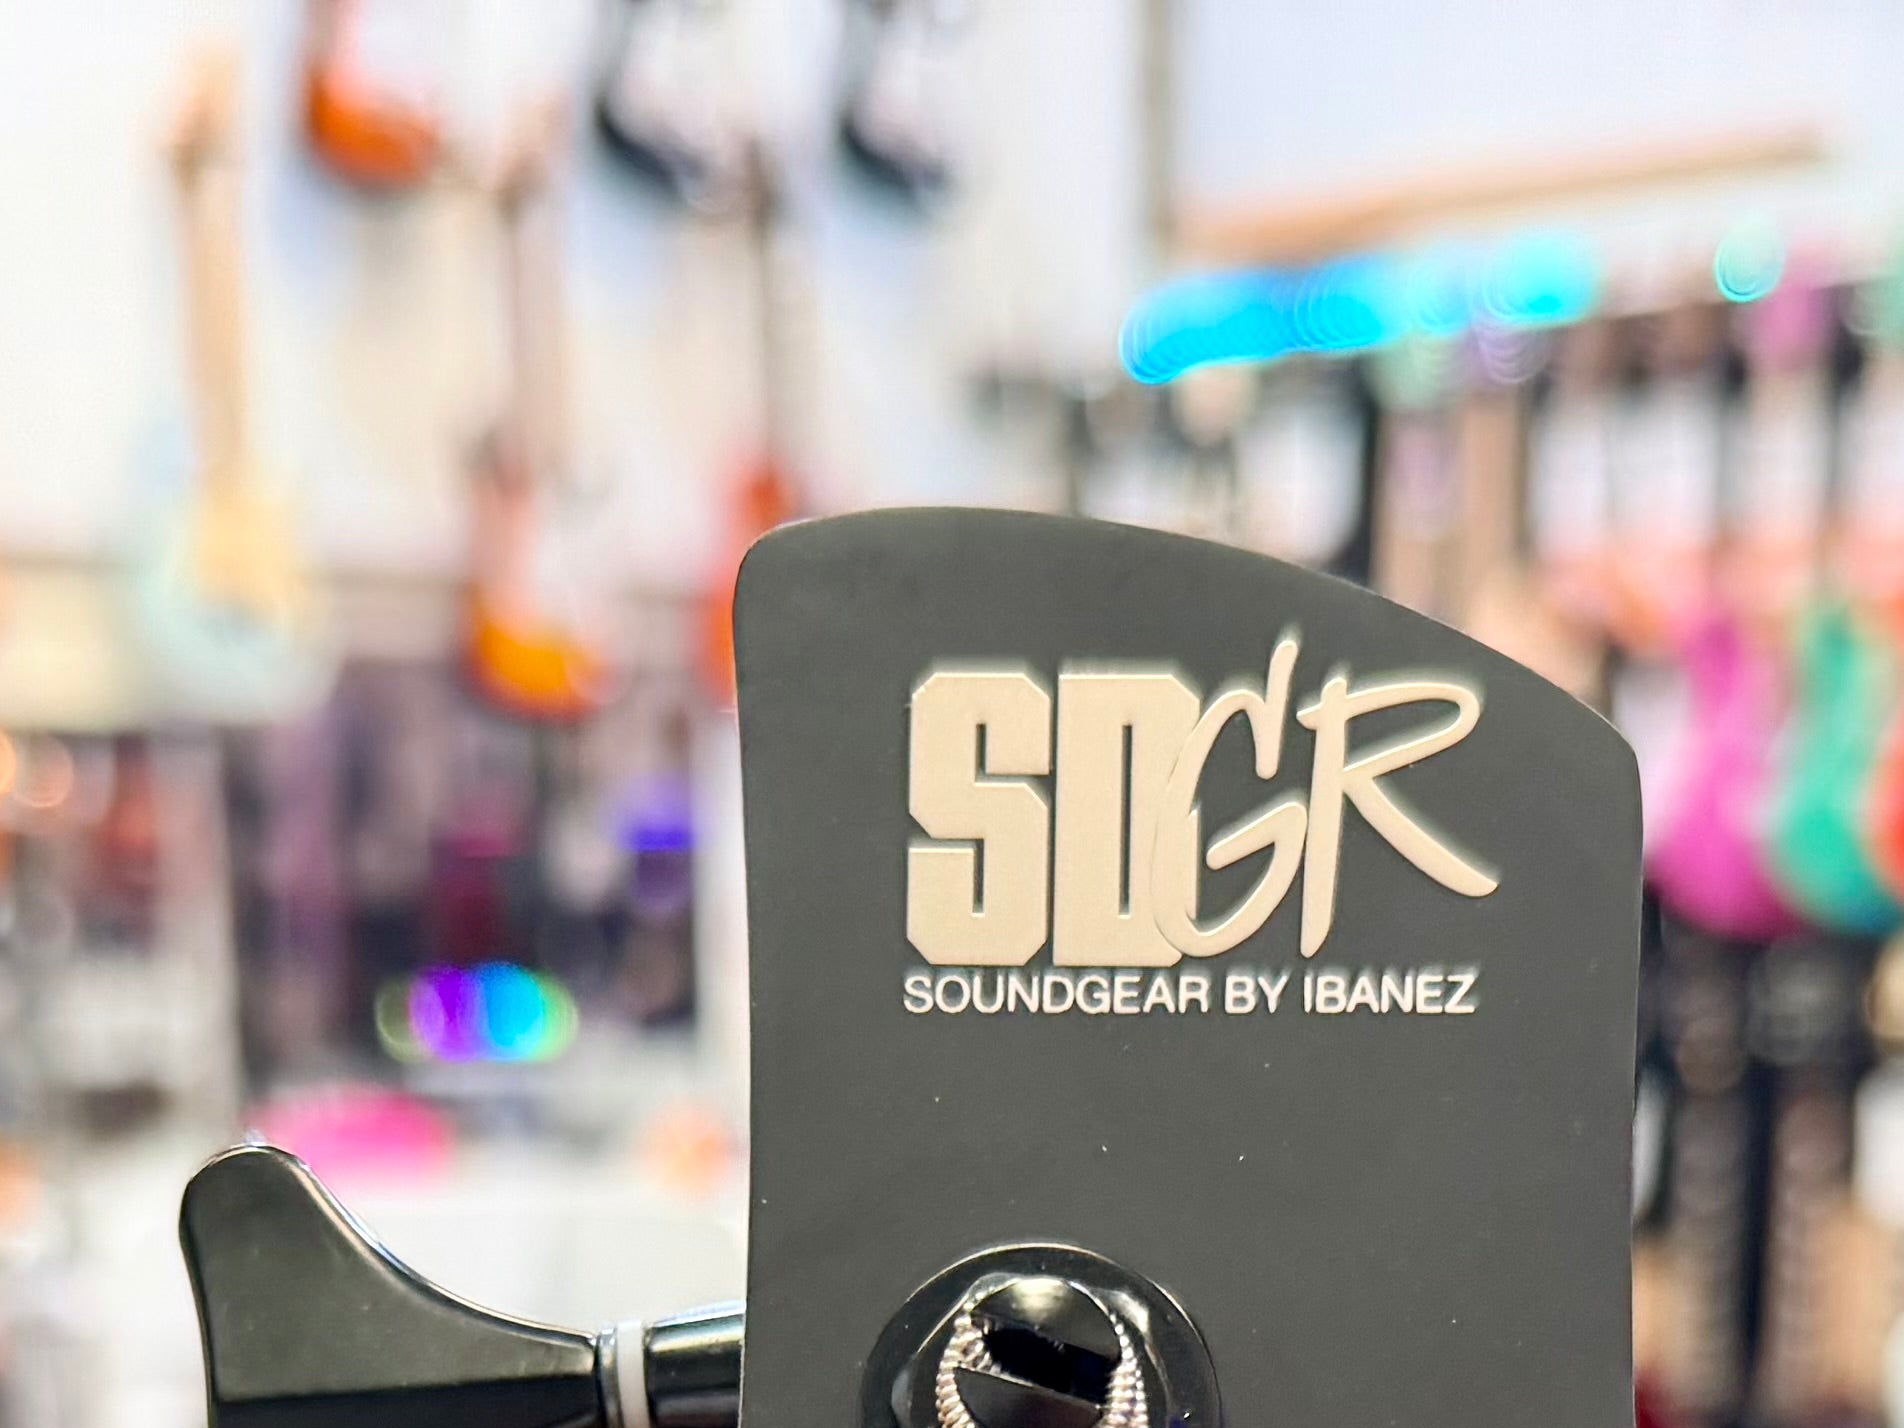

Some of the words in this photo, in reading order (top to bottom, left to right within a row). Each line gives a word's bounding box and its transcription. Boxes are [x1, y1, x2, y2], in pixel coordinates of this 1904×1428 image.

[906, 640, 1498, 967] SDGR
[903, 974, 1209, 1013] SOUNDGEAR
[1224, 974, 1289, 1013] BY
[1303, 974, 1477, 1013] IBANEZ
